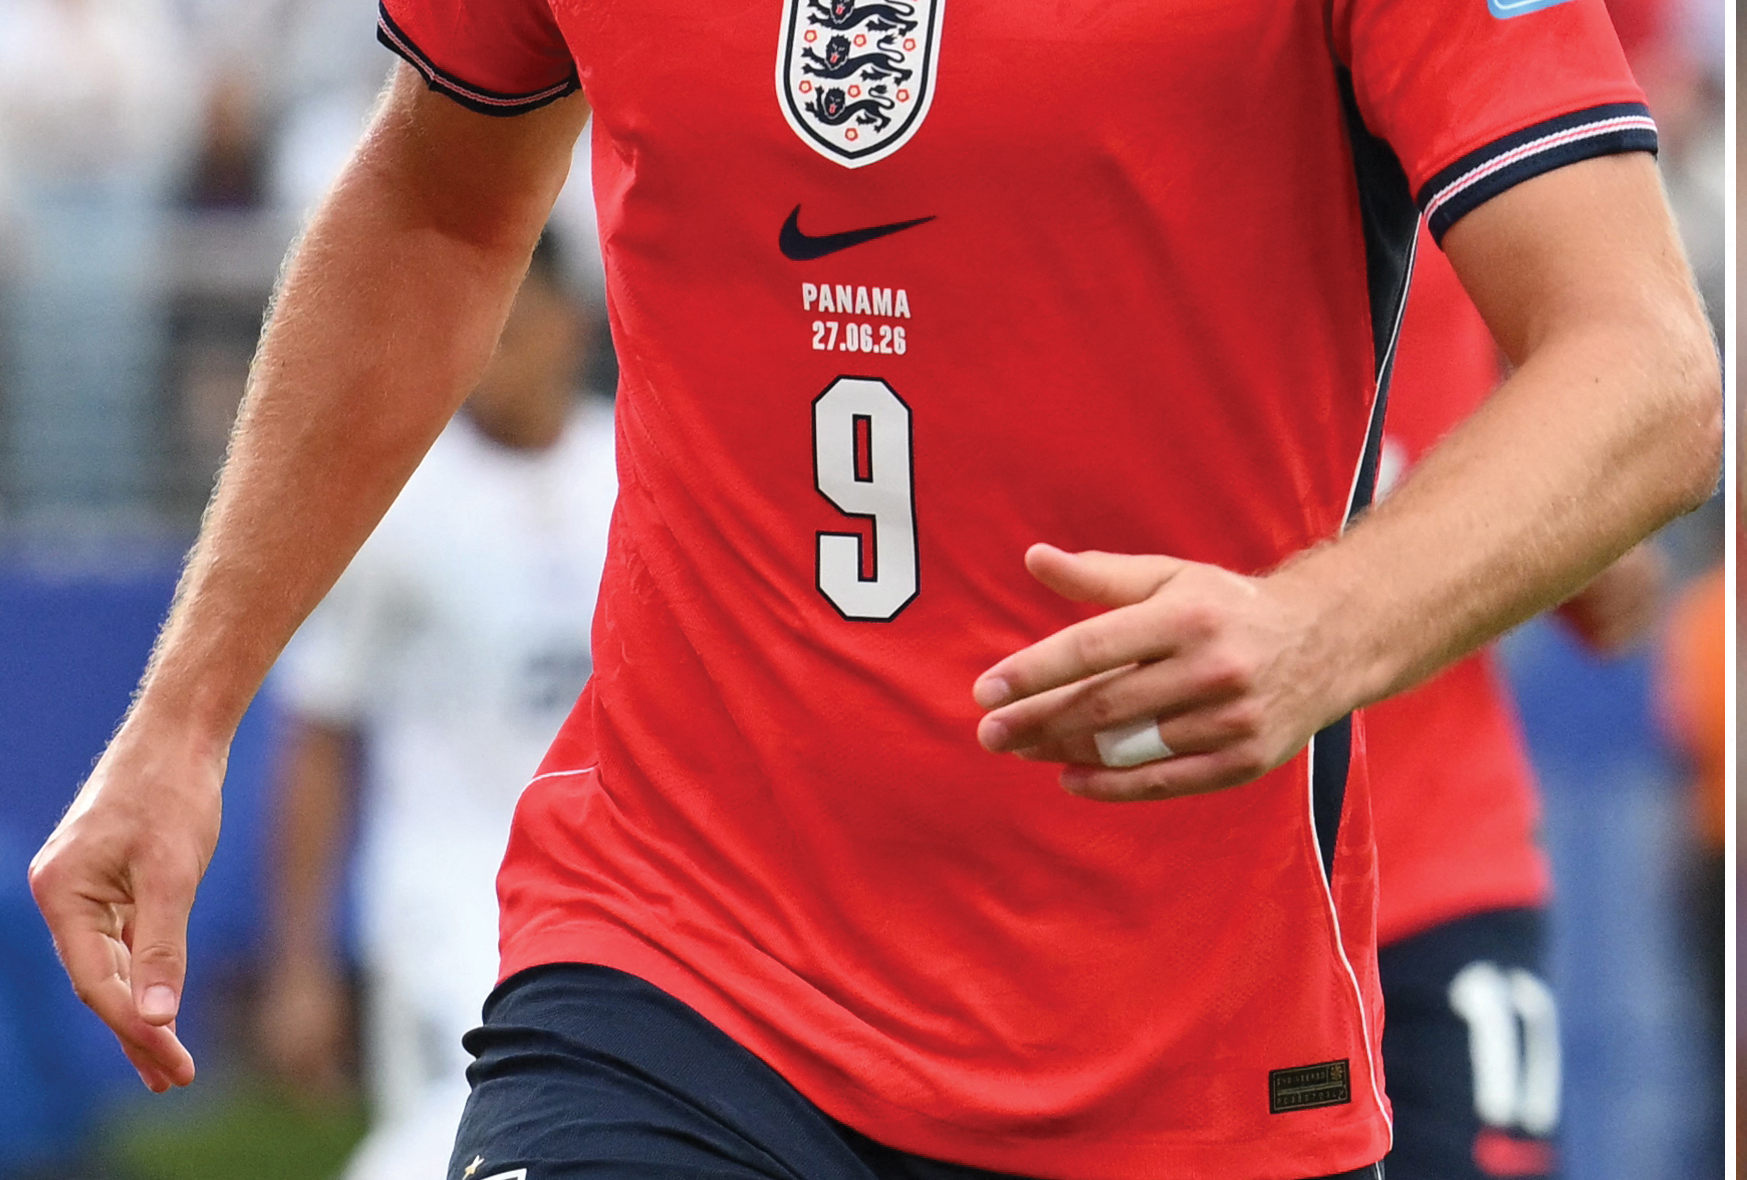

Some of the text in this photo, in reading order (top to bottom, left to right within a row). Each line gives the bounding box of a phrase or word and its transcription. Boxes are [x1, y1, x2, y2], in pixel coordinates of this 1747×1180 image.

[801, 282, 911, 319] PANAMA
[812, 320, 907, 355] 27.06.26
[811, 374, 921, 623] 9
